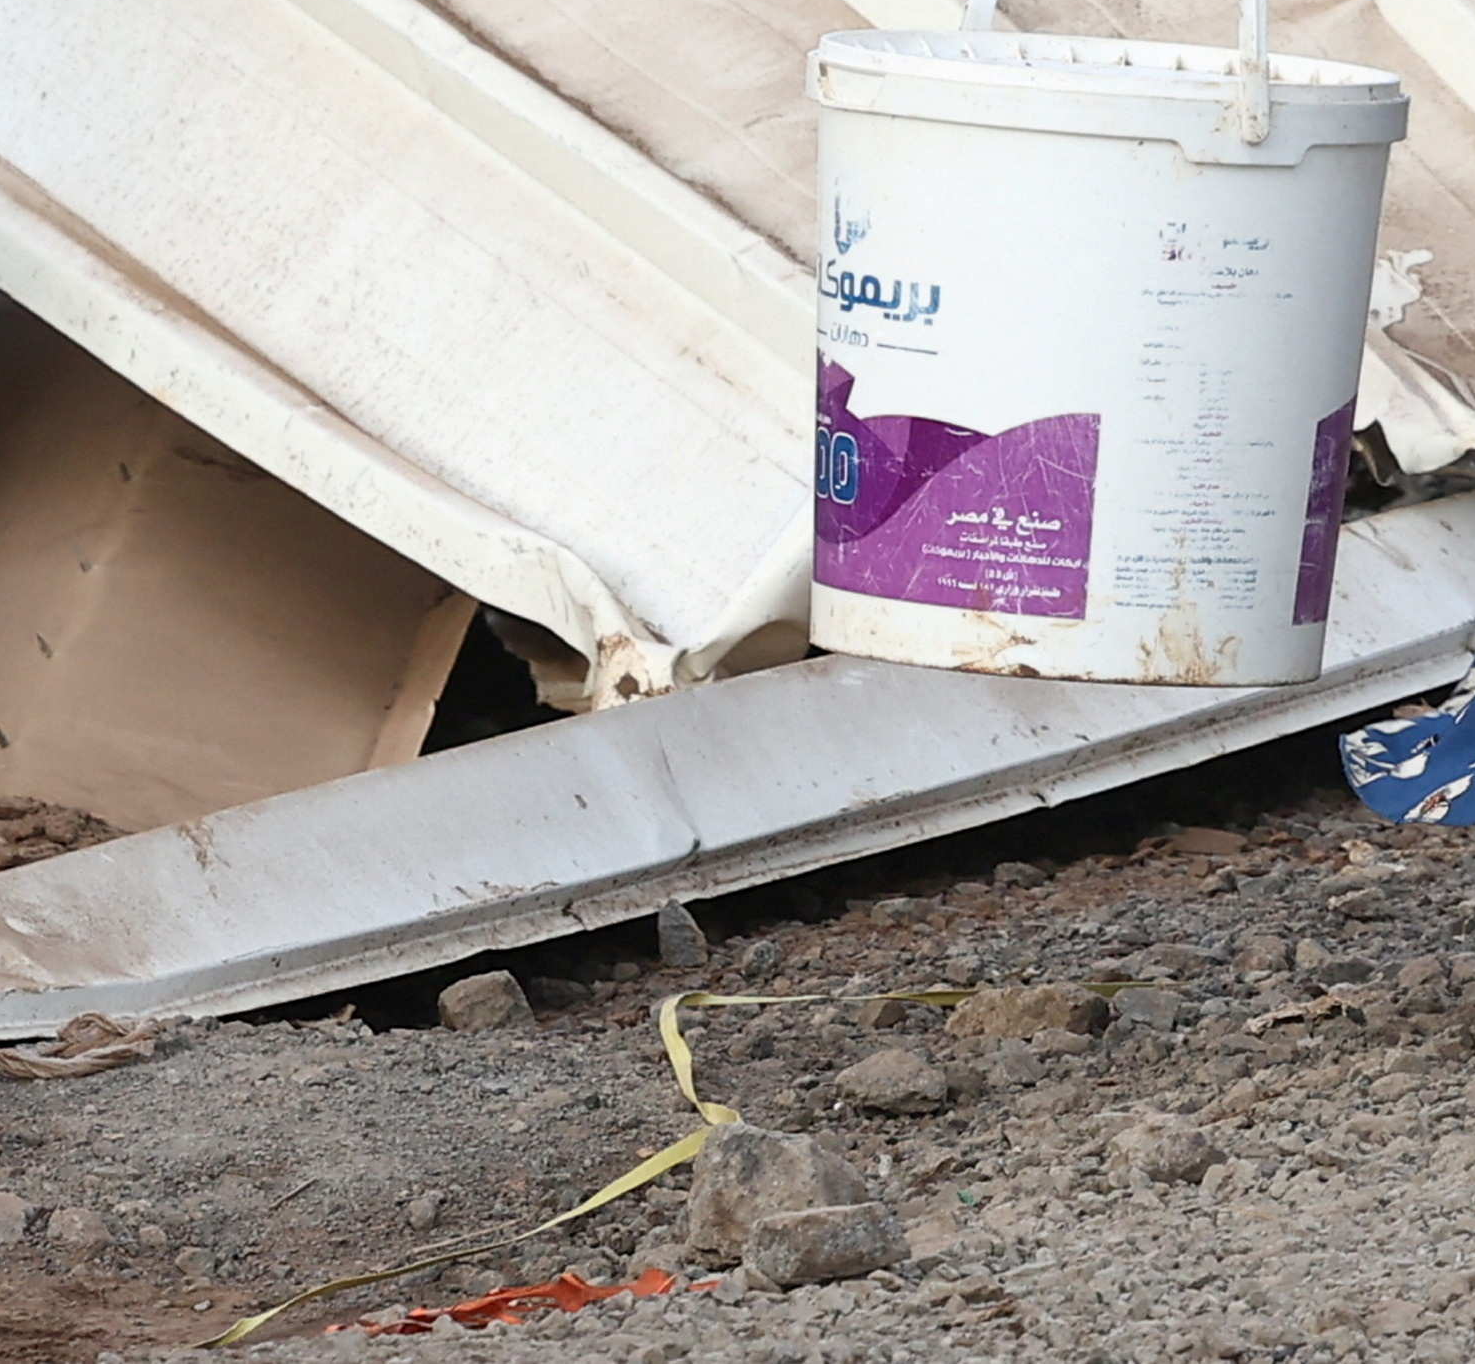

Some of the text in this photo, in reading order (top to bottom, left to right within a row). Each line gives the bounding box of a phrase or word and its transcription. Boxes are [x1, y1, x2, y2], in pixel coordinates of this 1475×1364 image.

[945, 506, 1062, 535] صنع في مصر
